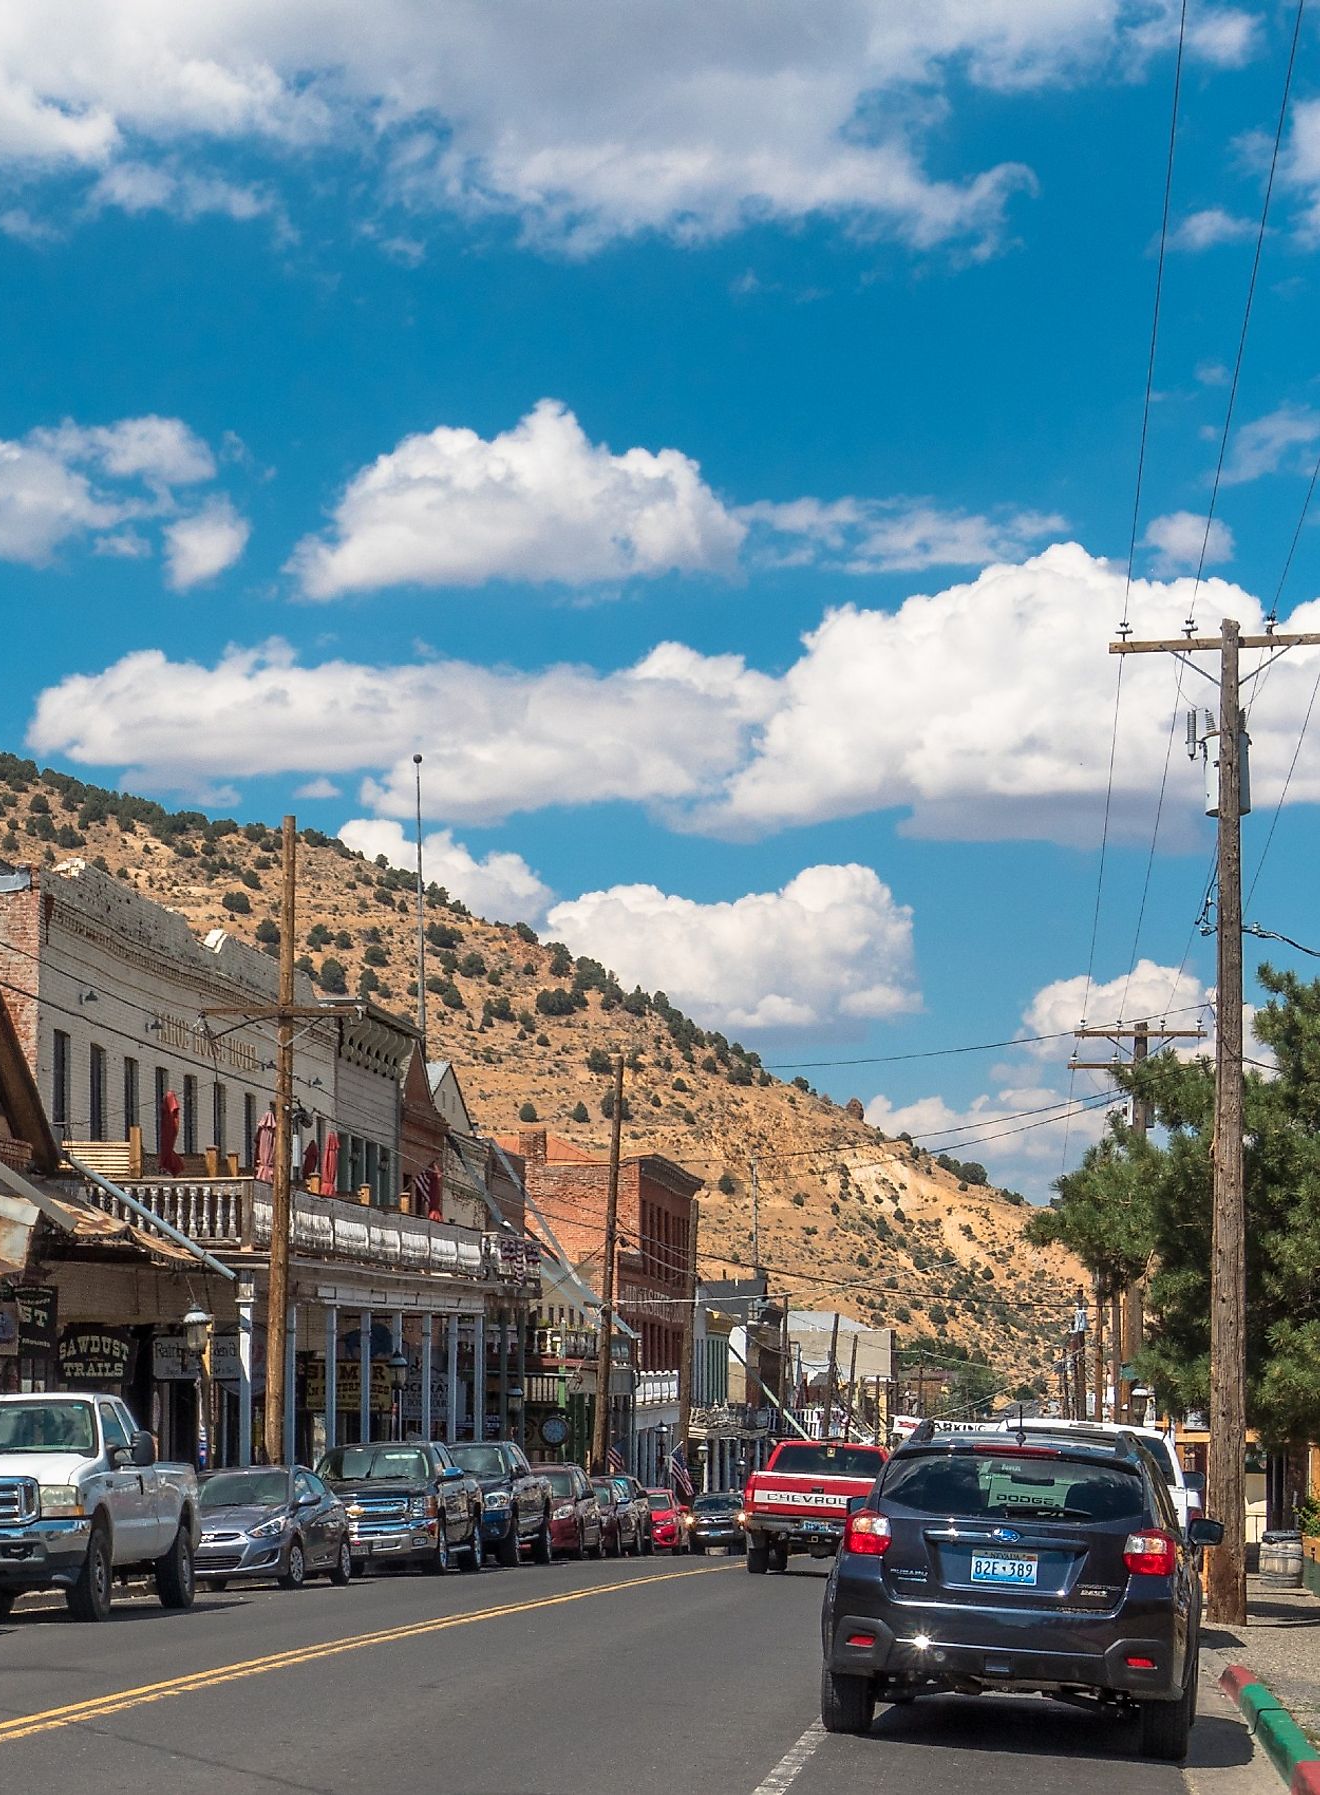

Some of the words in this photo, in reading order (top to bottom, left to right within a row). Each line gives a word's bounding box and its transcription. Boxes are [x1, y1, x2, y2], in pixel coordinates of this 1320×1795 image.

[59, 1335, 129, 1361] SAWDUST
[63, 1362, 125, 1377] TRAILS
[934, 1422, 986, 1432] ARKING
[767, 1493, 848, 1506] CHEVROL
[996, 1494, 1055, 1506] DODGE
